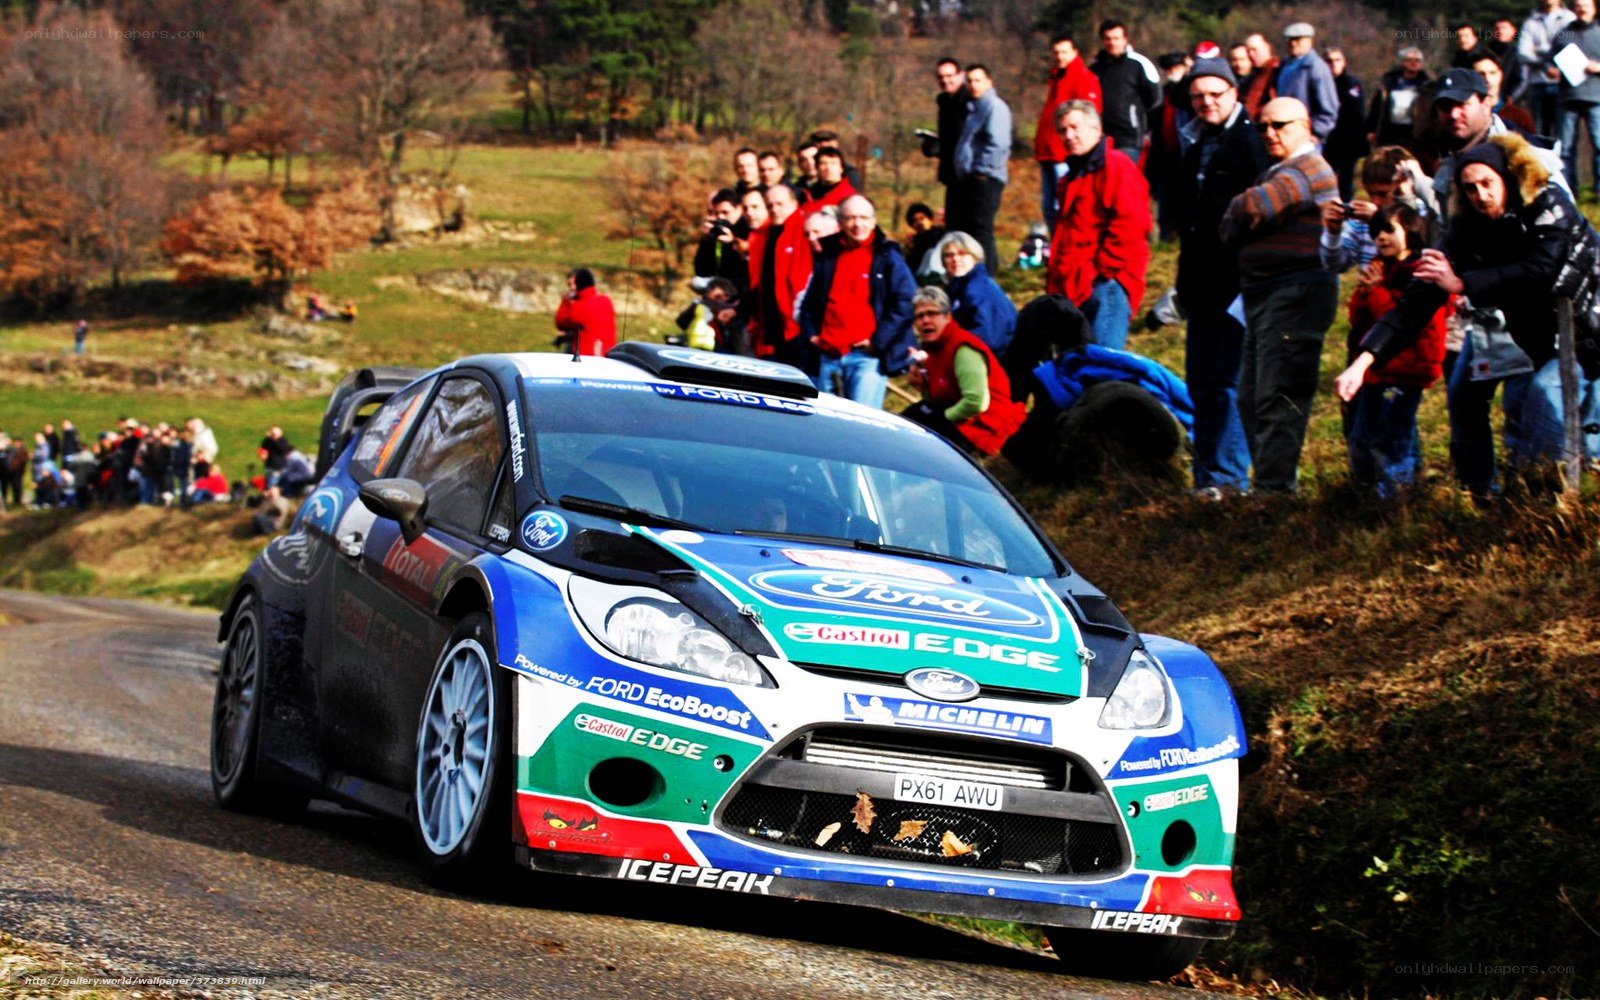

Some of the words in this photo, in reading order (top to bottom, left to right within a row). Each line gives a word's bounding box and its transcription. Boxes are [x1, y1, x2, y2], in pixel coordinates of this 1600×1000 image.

[656, 385, 677, 395] by
[681, 385, 760, 405] FORD
[524, 515, 559, 547] Ford
[389, 538, 431, 592] TOTAL
[812, 573, 992, 616] Ford
[817, 627, 900, 646] Castrol
[914, 632, 1063, 673] EDGE
[514, 653, 567, 683] Powered
[567, 674, 584, 688] by
[585, 677, 645, 702] FORD
[644, 687, 752, 730] EcoBoost
[922, 671, 965, 693] Ford
[898, 701, 1046, 735] MICHELIN
[588, 718, 628, 739] Castrol
[629, 729, 709, 760] EDGE
[1121, 757, 1152, 772] Powered
[1152, 757, 1162, 770] by
[1161, 747, 1186, 767] FORD
[899, 778, 945, 801] PX61
[953, 781, 999, 807] AWU
[1174, 783, 1209, 806] EDGE
[617, 858, 775, 895] ICEPEAK
[1091, 910, 1184, 935] ICEPEAK
